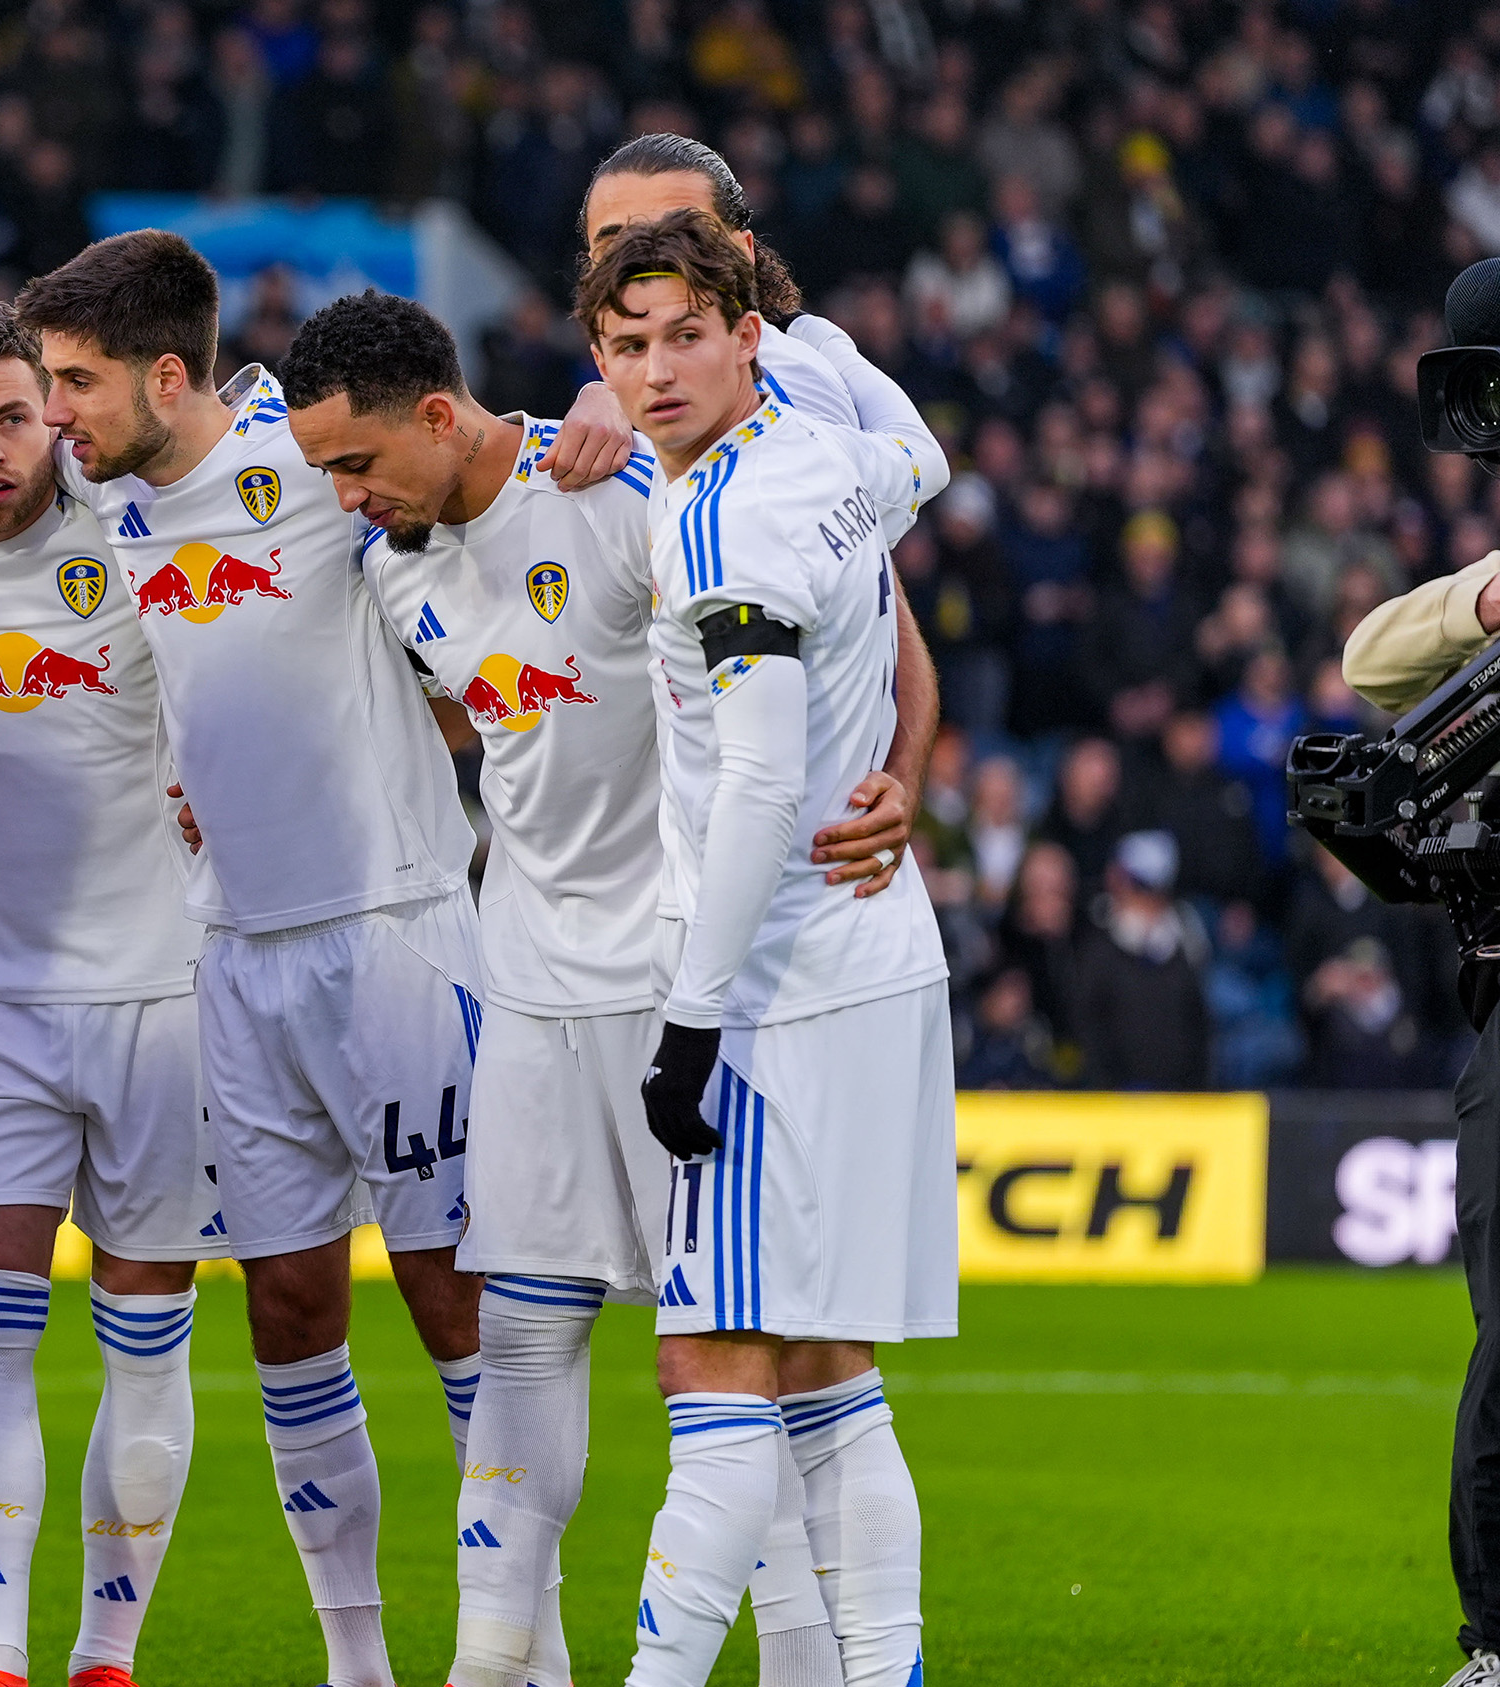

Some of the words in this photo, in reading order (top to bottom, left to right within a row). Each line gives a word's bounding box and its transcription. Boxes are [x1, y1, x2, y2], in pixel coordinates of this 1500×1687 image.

[817, 485, 876, 562] AARO
[384, 1085, 468, 1181] 44
[956, 1162, 1194, 1237] CH
[465, 1461, 527, 1484] UFC
[87, 1519, 164, 1538] LUFC
